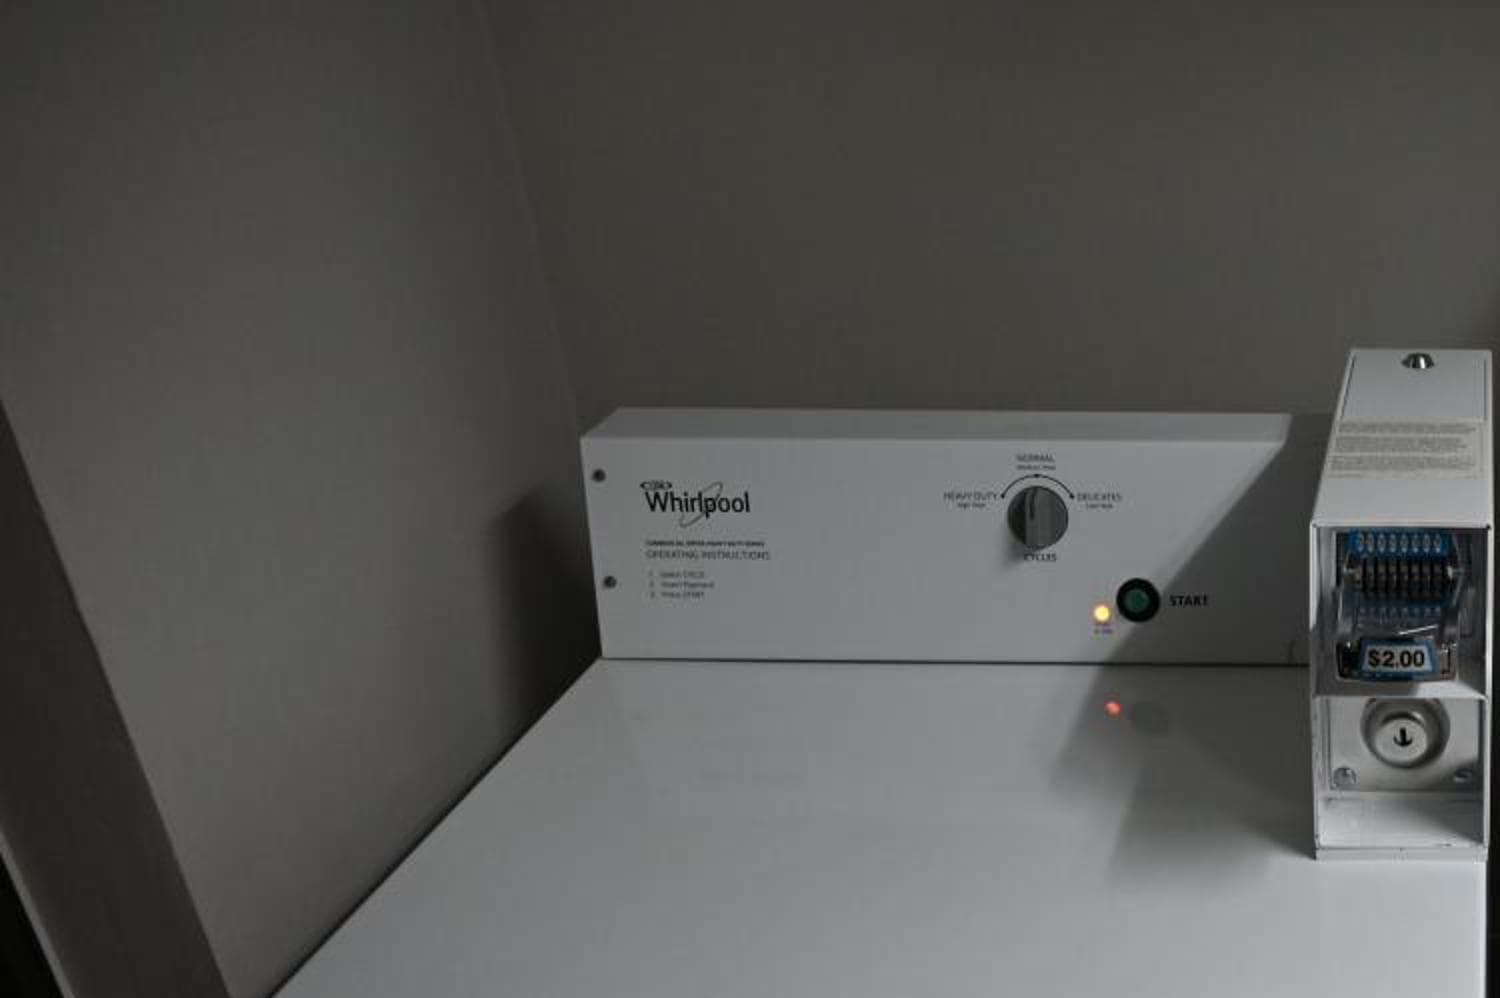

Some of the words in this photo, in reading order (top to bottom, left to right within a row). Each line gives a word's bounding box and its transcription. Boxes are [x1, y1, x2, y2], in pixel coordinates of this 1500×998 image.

[1016, 454, 1054, 462] NORMAL
[943, 492, 972, 501] HEAVY
[974, 492, 998, 501] DUTY
[645, 491, 751, 520] Whirlpool
[1168, 595, 1209, 606] START
[1368, 649, 1425, 668] $2.00
